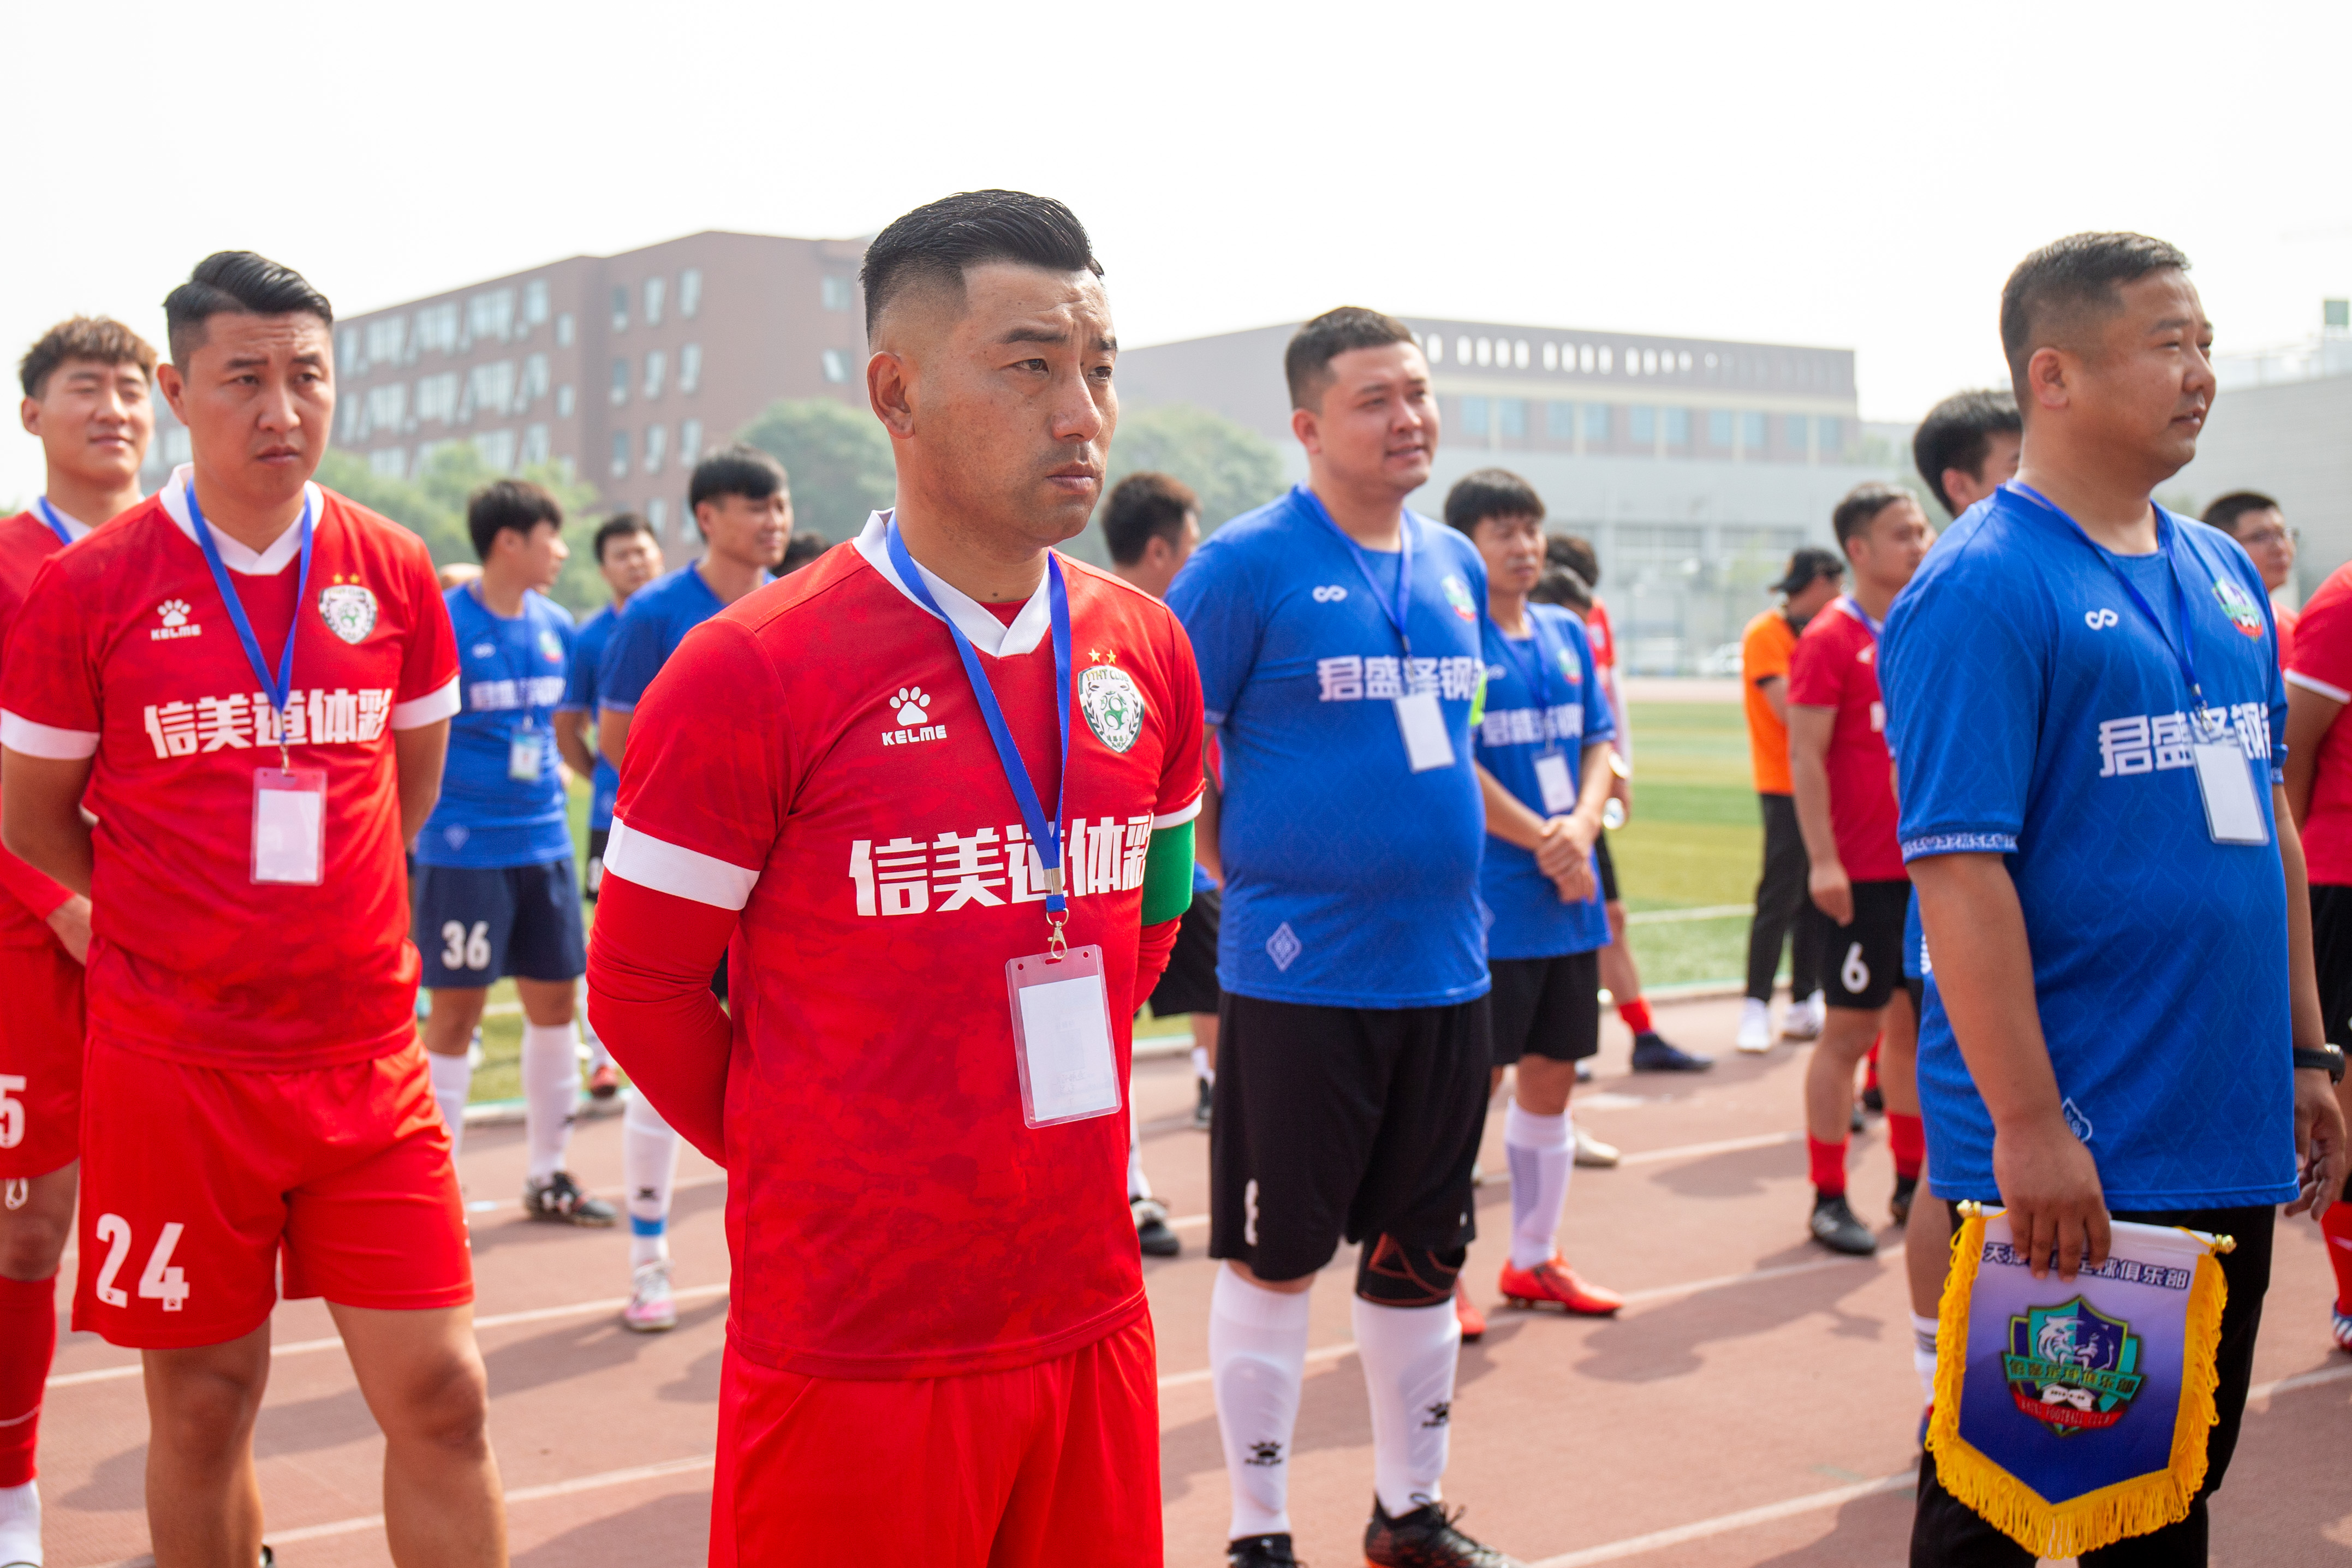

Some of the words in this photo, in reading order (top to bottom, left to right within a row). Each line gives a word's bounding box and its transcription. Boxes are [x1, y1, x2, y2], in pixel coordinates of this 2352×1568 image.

[151, 624, 201, 641] KELME
[1110, 670, 1129, 682] CLUB
[144, 688, 392, 759] 信美道体彩
[882, 725, 947, 746] KELME
[441, 919, 491, 971] 36
[1841, 941, 1871, 994] 6
[0, 1074, 27, 1149] 5
[96, 1213, 190, 1312] 24
